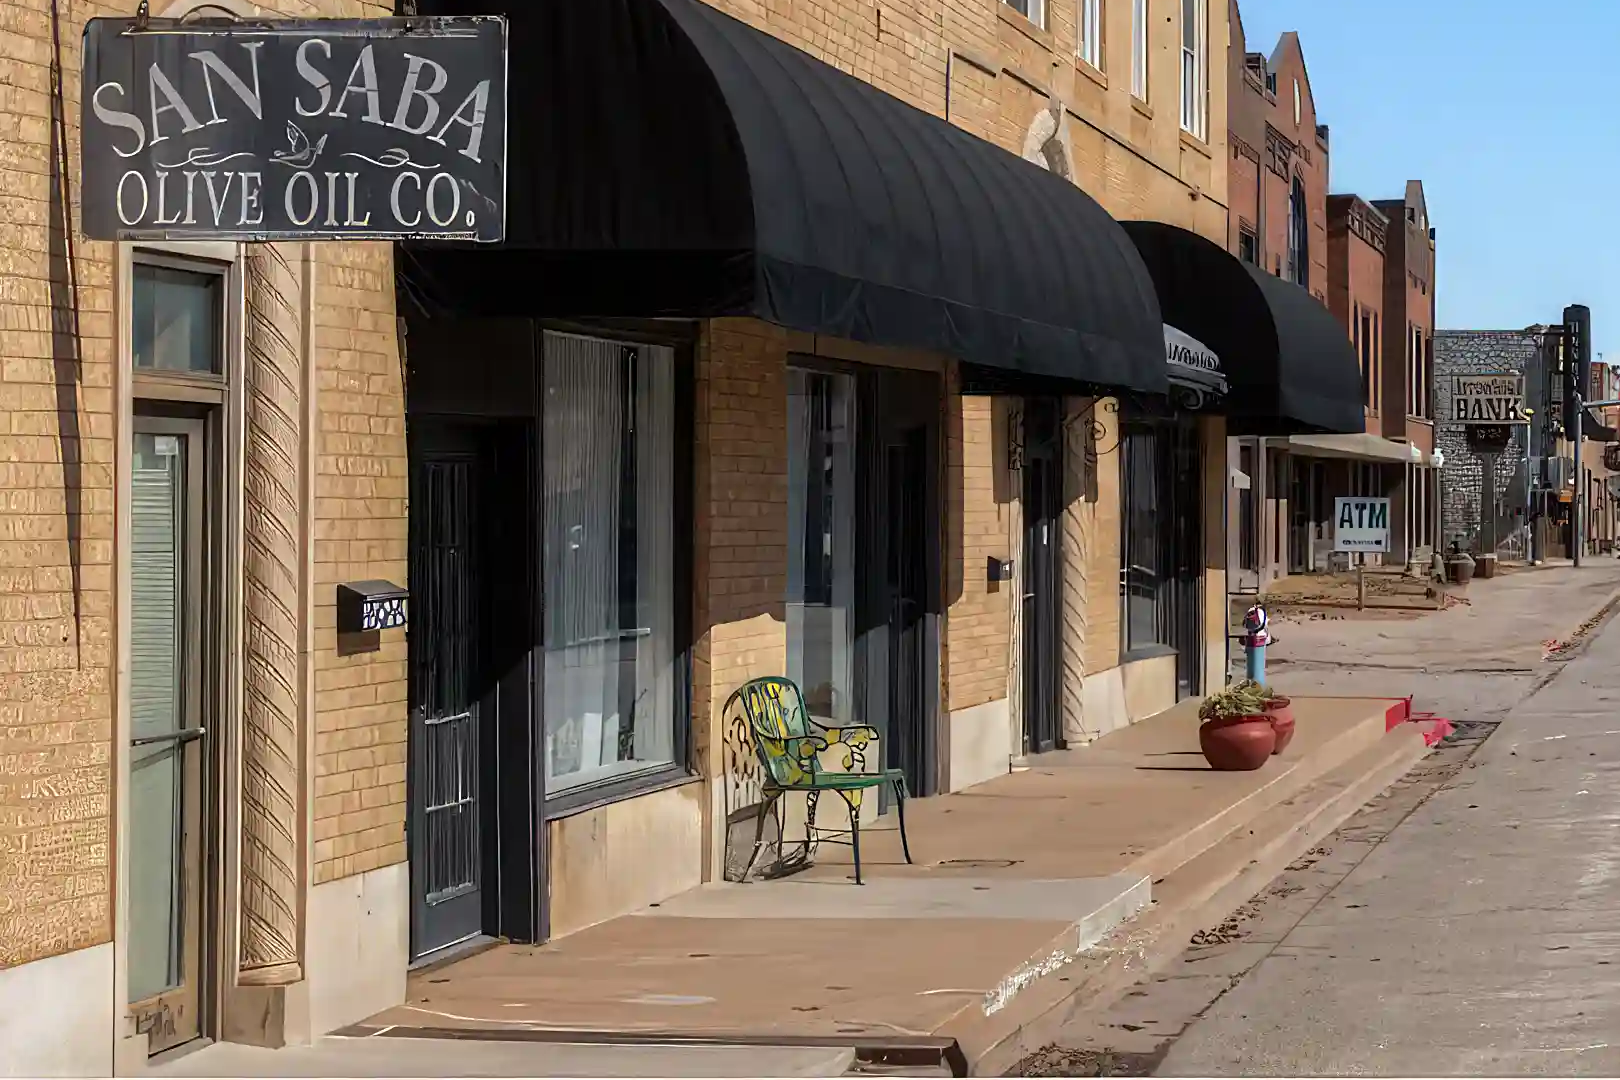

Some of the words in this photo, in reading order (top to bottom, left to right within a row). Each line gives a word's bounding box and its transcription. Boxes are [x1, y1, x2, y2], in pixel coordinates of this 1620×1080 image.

[93, 41, 265, 158] SAN
[294, 39, 490, 163] SABA
[116, 170, 263, 225] OLIVE
[284, 170, 371, 226] OIL
[390, 170, 476, 227] CO.
[1339, 502, 1387, 529] ATM
